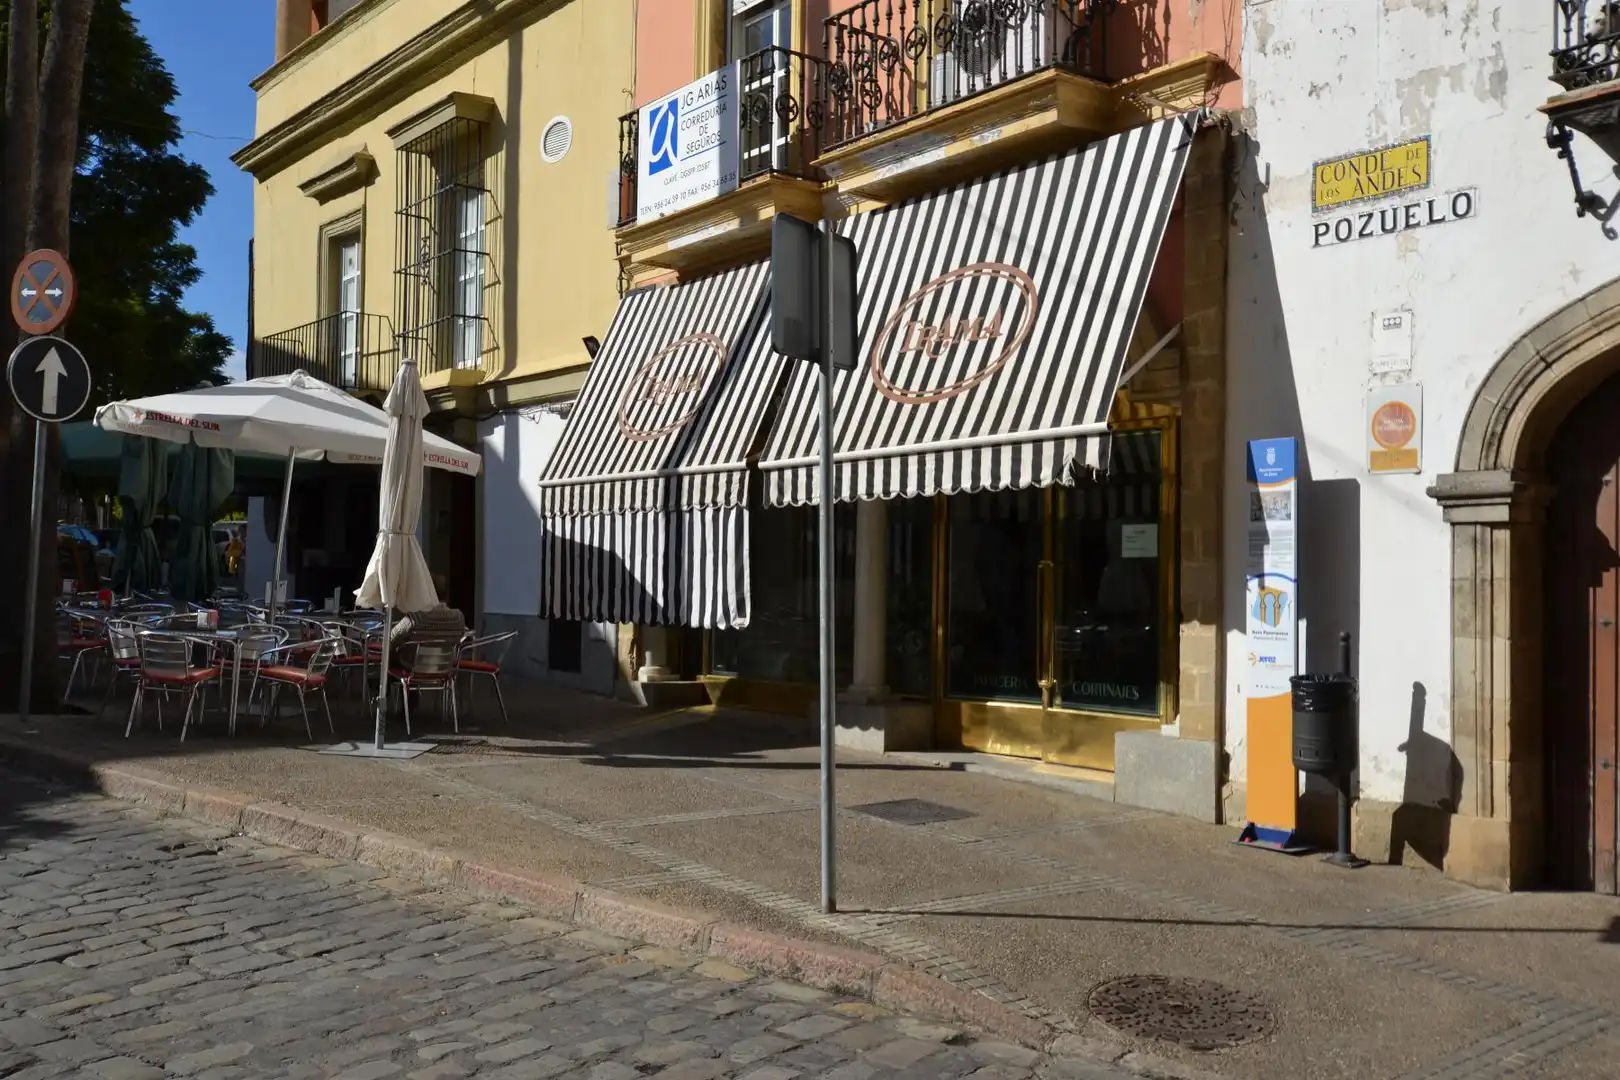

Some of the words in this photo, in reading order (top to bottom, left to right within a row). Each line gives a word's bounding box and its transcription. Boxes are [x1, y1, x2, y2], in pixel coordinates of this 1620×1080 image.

[681, 91, 694, 110] JG
[697, 75, 727, 102] ARIAS
[680, 103, 727, 132] CORREDURIA
[698, 123, 709, 137] DE
[686, 130, 721, 155] SEGUROS
[1320, 151, 1392, 184] CONDE
[1406, 147, 1422, 162] DE
[1320, 187, 1340, 201] LOS
[1352, 163, 1422, 197] ANDES
[1312, 192, 1472, 248] POZUELO
[897, 303, 1004, 359] TRAMA
[145, 411, 183, 425] ESTRELLA
[184, 418, 201, 428] DEL
[202, 421, 220, 432] SUR
[428, 453, 451, 465] ESTRELLA
